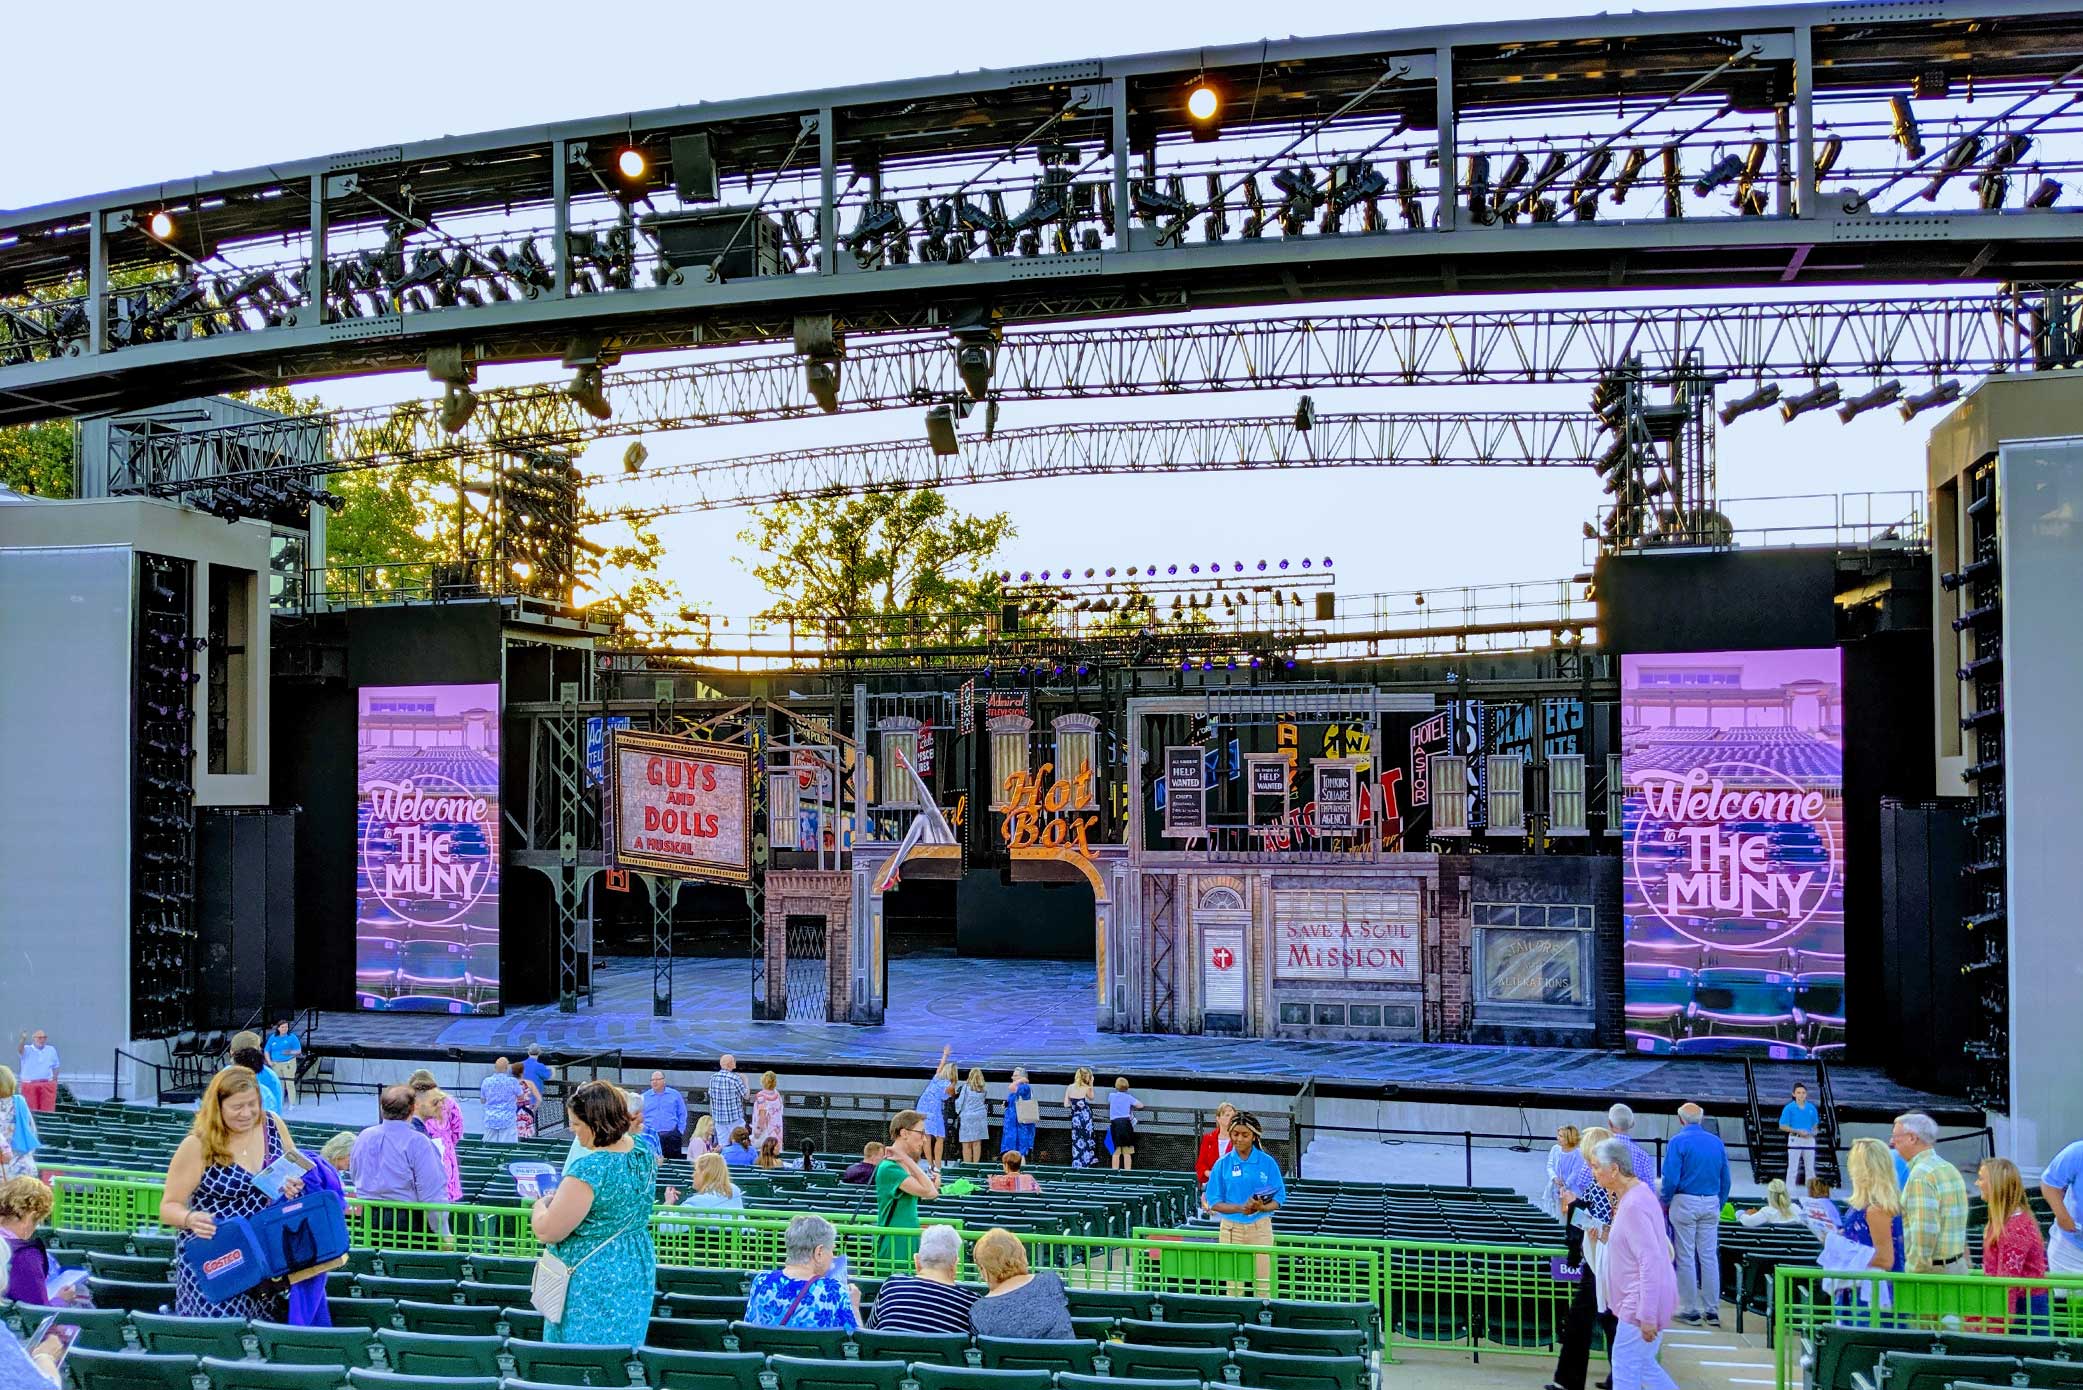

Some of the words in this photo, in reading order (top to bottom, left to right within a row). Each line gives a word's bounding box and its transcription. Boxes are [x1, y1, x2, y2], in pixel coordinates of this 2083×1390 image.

[963, 686, 971, 730] AUTOMAT
[988, 694, 1025, 707] Admiral
[988, 708, 1025, 717] TELEVISION
[1413, 717, 1447, 747] HOTEL
[1496, 698, 1584, 744] PLANERS
[646, 756, 717, 792] GUYS
[1001, 758, 1094, 813] Hot
[1171, 778, 1200, 787] WANTED
[1173, 768, 1196, 777] HELP
[1257, 782, 1283, 790] WANTED
[1259, 773, 1280, 781] HELP
[1414, 747, 1426, 802] ASTOR
[363, 778, 488, 823] Welcome
[666, 791, 696, 807] AND
[1321, 787, 1349, 801] SQUARE
[1630, 767, 1826, 823] Welcome
[645, 805, 719, 838] DOLLS
[1001, 805, 1100, 859] Box
[1321, 813, 1348, 825] AGENCY
[393, 823, 453, 866] THE
[634, 836, 644, 849] A
[646, 837, 694, 856] MUSICAL
[1678, 823, 1769, 873] THE
[385, 862, 481, 901] MUNY
[1665, 871, 1814, 919] MUNY
[204, 1250, 241, 1273] COSTCO
[1560, 1263, 1581, 1275] Box
